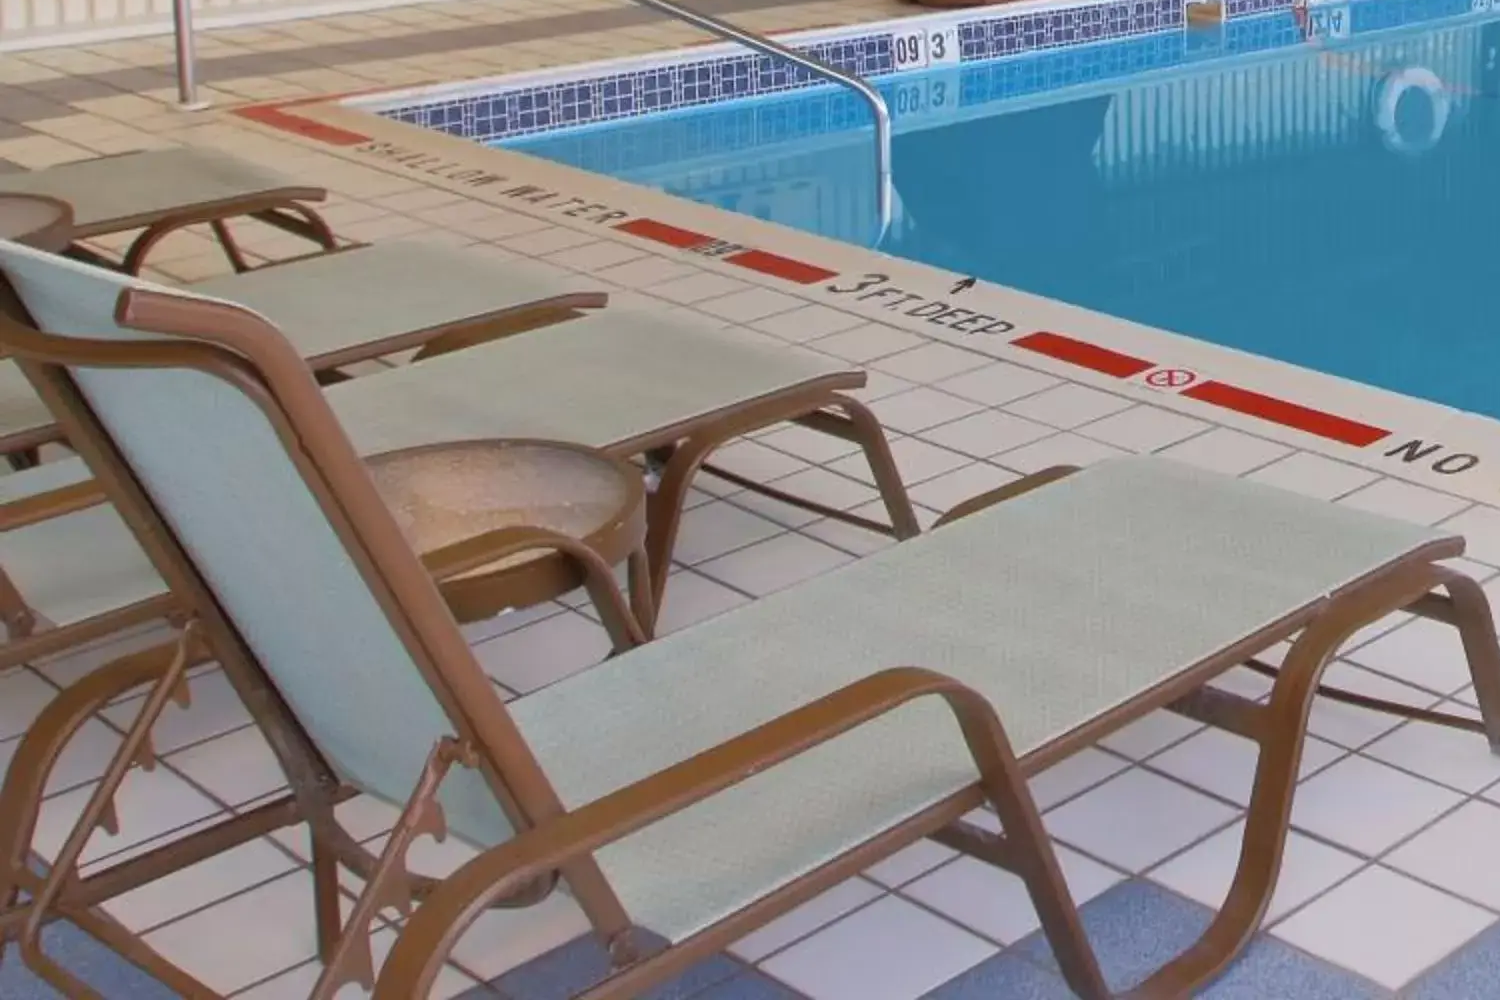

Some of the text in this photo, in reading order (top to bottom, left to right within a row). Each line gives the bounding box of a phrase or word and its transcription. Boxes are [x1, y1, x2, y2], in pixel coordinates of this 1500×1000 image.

[897, 35, 919, 64] 09
[931, 32, 946, 59] 3
[354, 139, 629, 224] SHALLOW WATER
[826, 273, 890, 293] 3
[903, 300, 1016, 336] DEEP
[1384, 438, 1480, 475] NO
